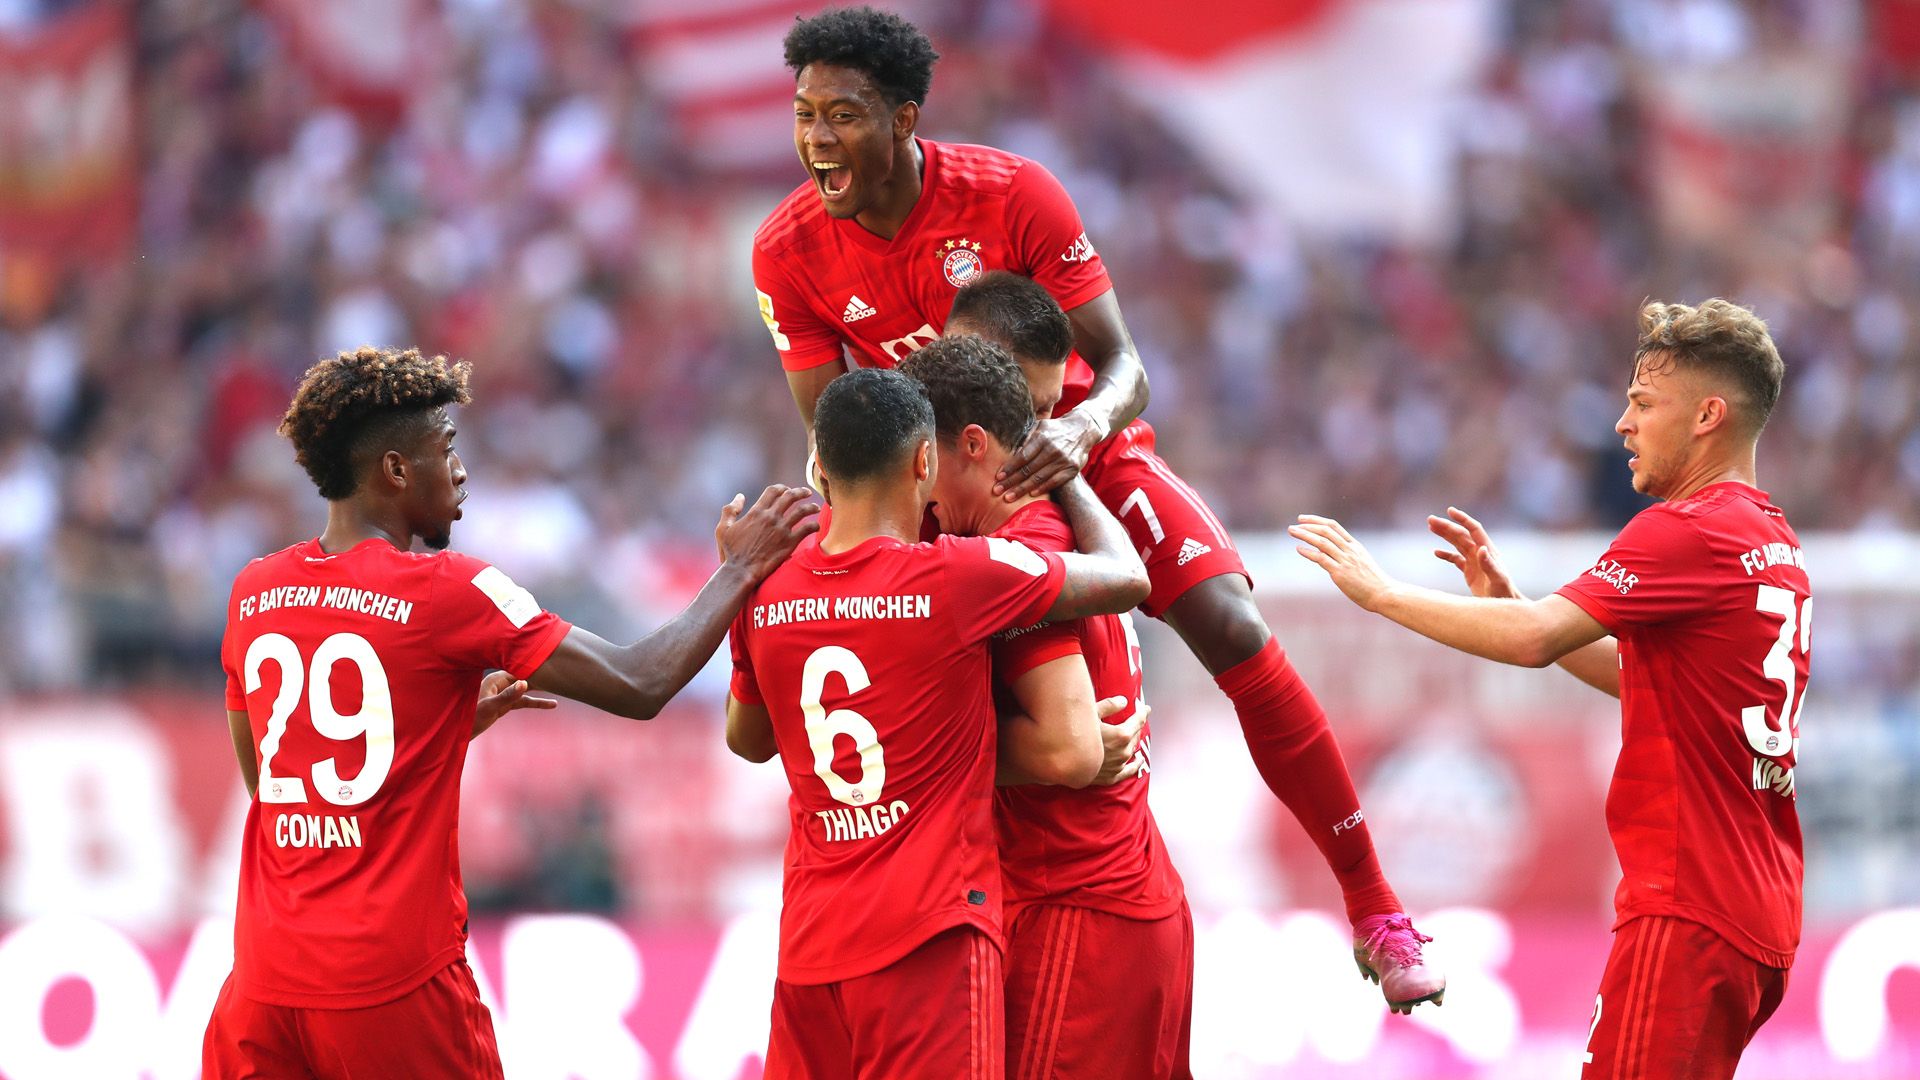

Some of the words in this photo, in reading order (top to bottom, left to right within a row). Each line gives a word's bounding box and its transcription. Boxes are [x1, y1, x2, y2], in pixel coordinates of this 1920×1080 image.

[843, 306, 877, 323] adidas
[1177, 544, 1212, 566] adidas
[1740, 549, 1766, 577] FC
[1588, 567, 1630, 595] AIRWAYS
[239, 595, 257, 622] FC
[258, 586, 322, 613] BAYERN
[753, 604, 766, 630] FC
[767, 597, 829, 627] BAYERN
[244, 632, 395, 807] 29
[800, 645, 887, 807] 6
[275, 814, 362, 849] COMAN
[815, 800, 910, 842] THIAGO
[1332, 809, 1364, 836] FCB
